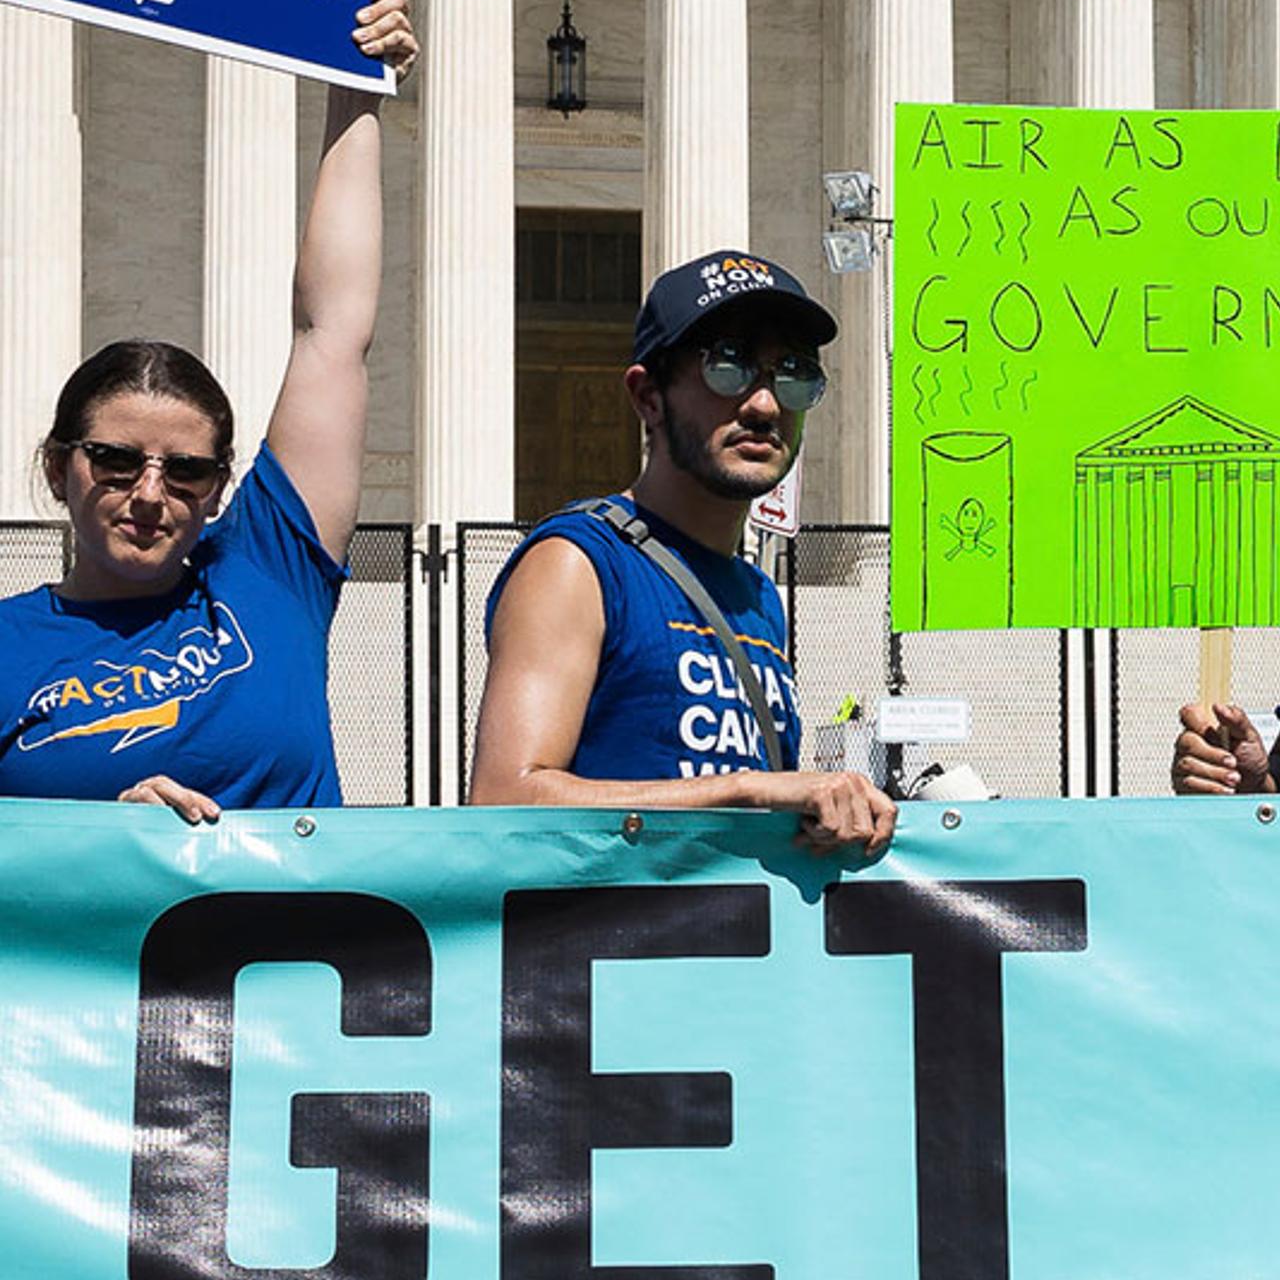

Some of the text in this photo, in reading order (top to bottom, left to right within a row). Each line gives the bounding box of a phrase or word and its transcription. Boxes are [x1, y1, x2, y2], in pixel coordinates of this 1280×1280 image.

[912, 109, 1048, 174] AIR
[1105, 116, 1185, 171] AS
[1057, 186, 1142, 238] AS
[700, 257, 770, 279] #ACT
[706, 269, 775, 291] NOW
[697, 288, 722, 307] ON
